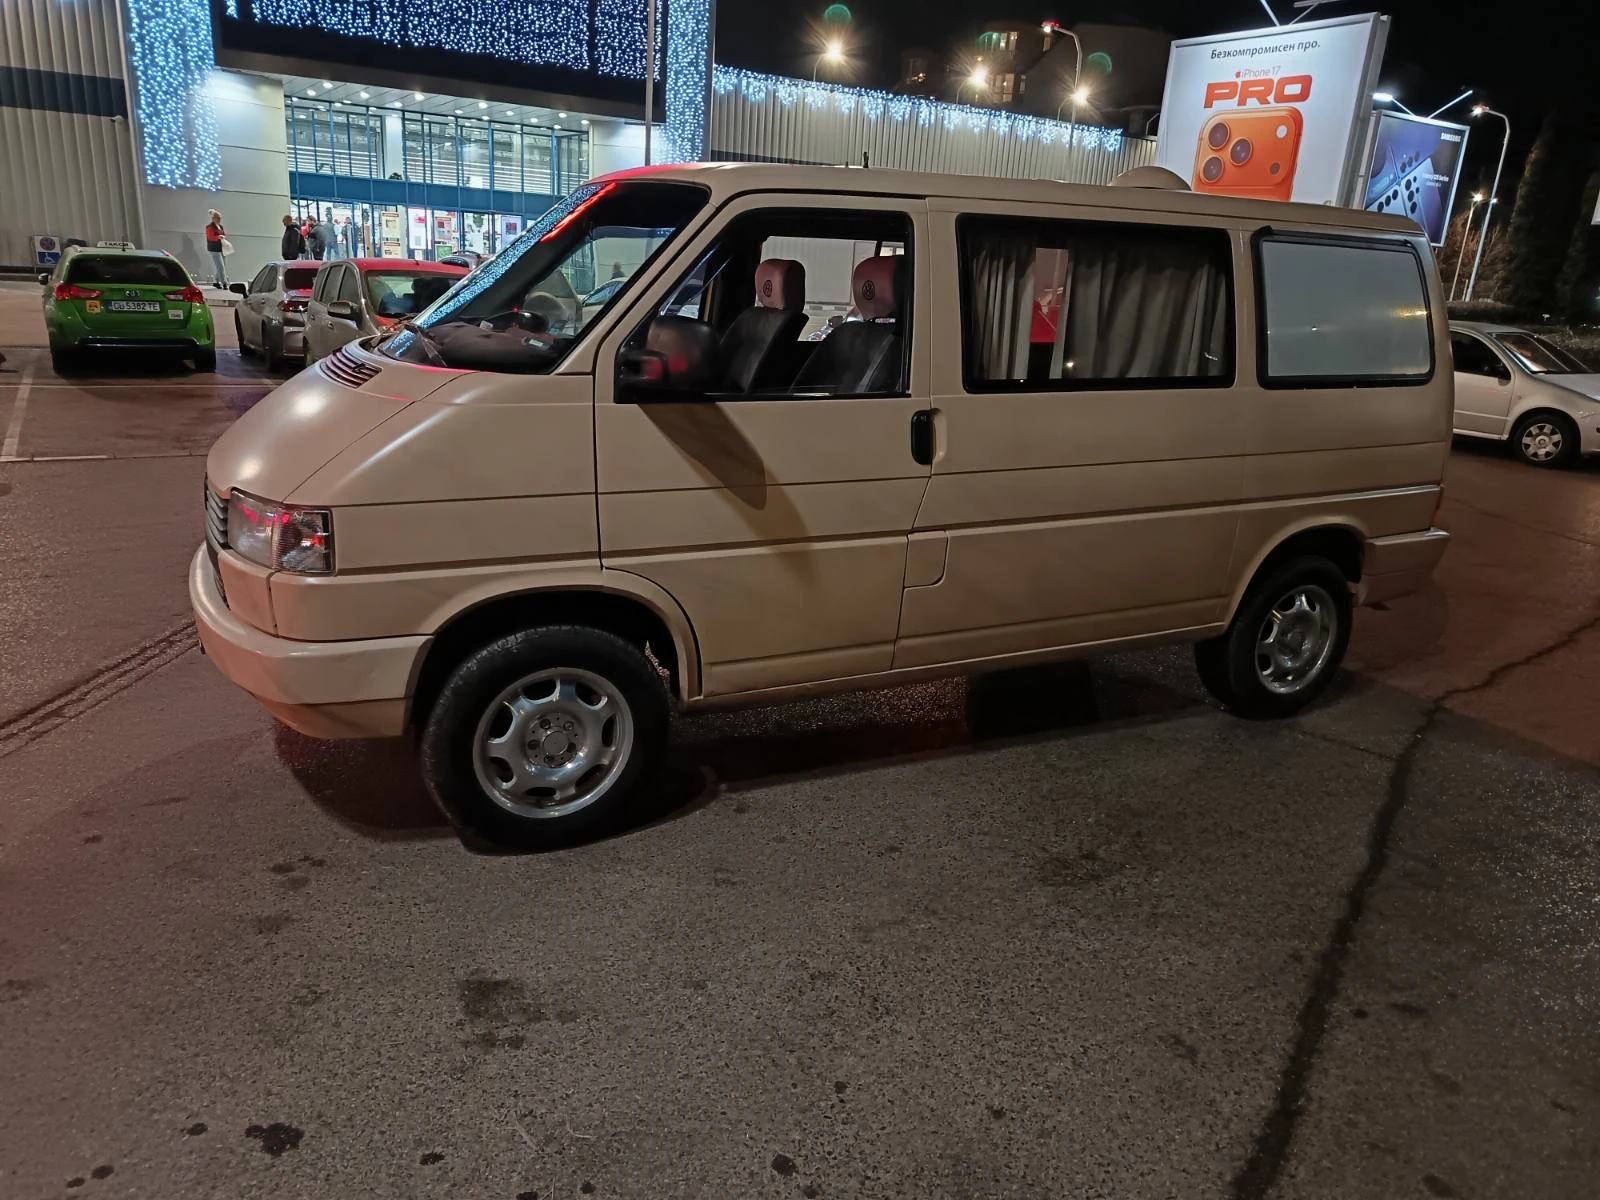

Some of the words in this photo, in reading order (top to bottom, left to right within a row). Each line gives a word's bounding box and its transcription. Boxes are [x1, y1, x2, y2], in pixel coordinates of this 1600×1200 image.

[1210, 44, 1295, 59] Безкомпромисен
[1241, 67, 1271, 79] iPhone
[1272, 65, 1282, 76] 17
[1203, 74, 1313, 109] PRO
